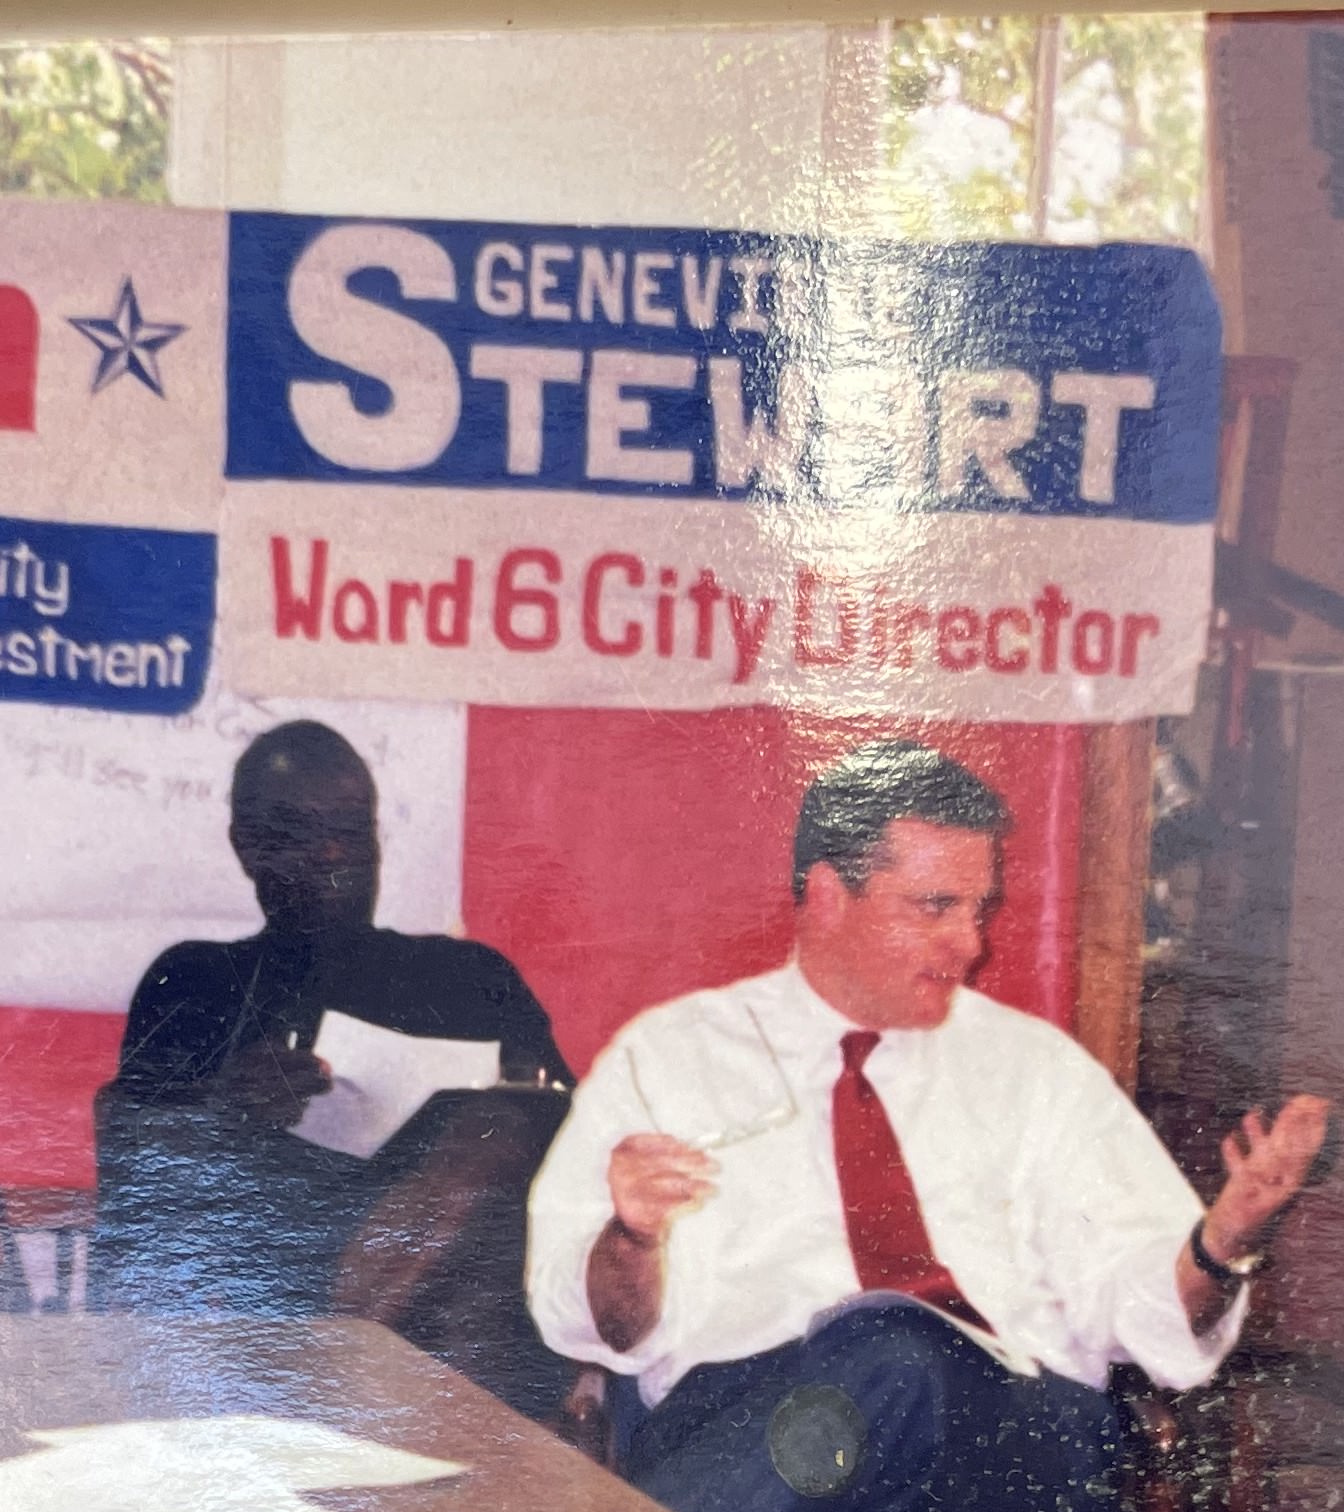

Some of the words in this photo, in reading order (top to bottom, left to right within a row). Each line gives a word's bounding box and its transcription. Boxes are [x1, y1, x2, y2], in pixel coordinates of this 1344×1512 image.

[270, 536, 474, 647] Ward
[493, 547, 561, 652] 6
[584, 552, 776, 685] City
[794, 565, 1162, 678] Director
